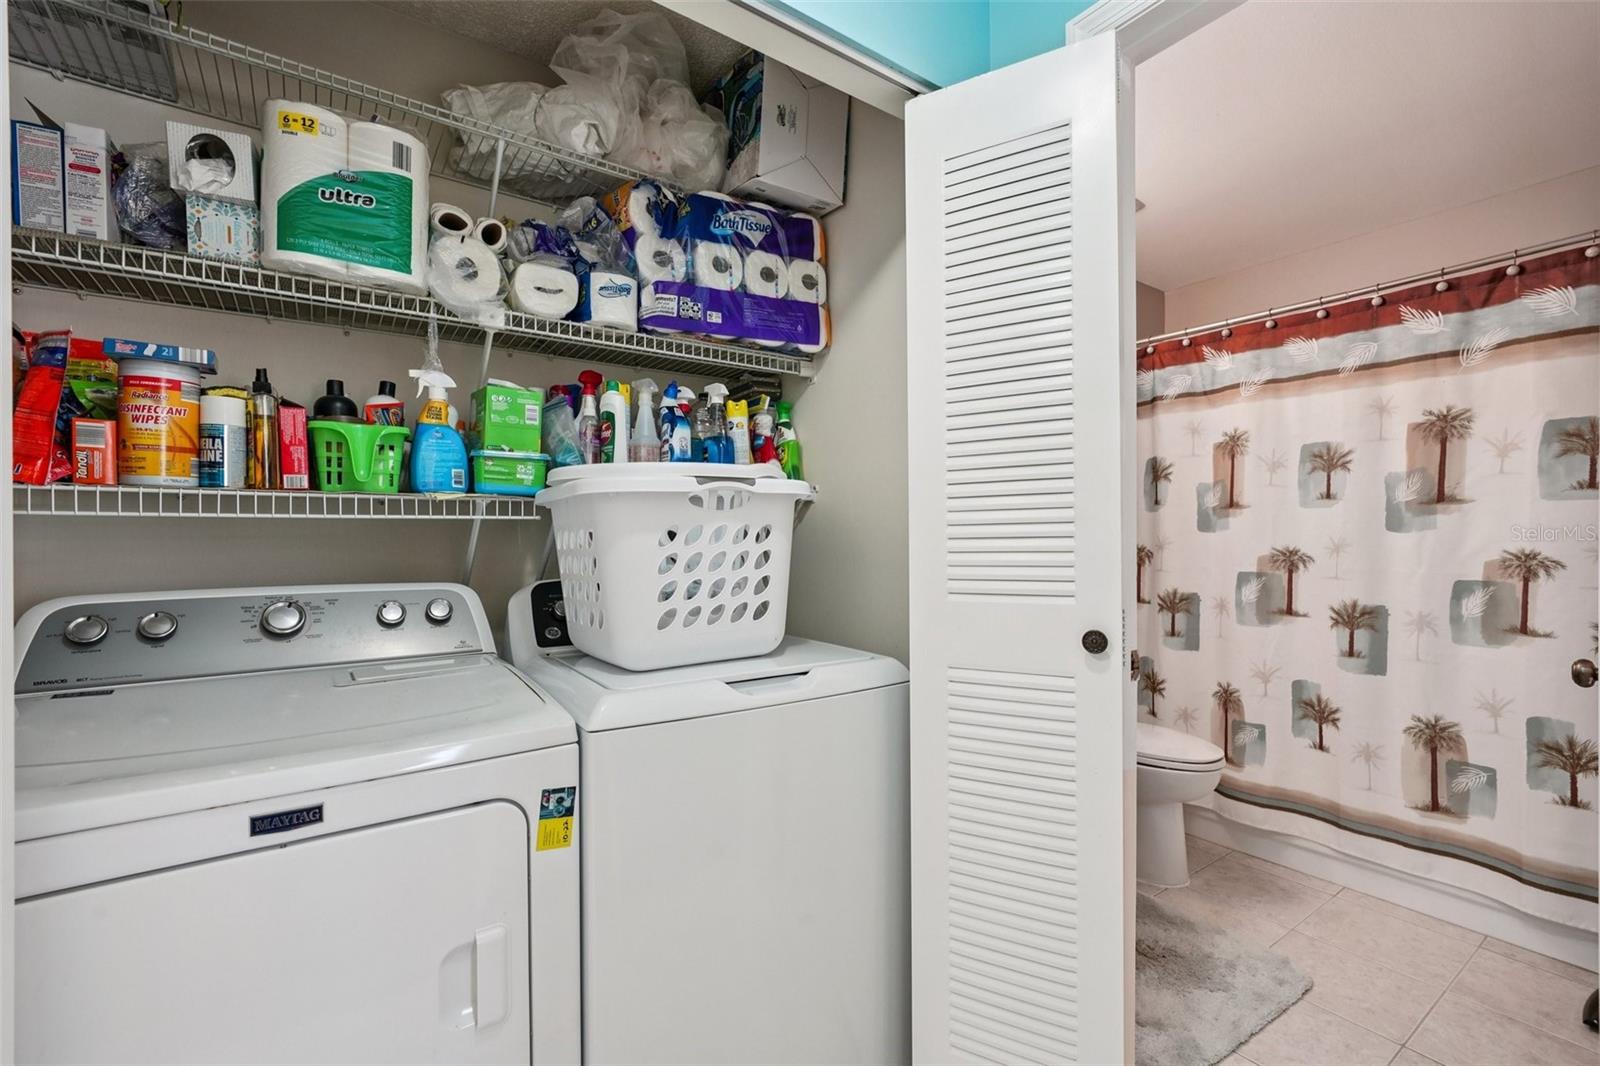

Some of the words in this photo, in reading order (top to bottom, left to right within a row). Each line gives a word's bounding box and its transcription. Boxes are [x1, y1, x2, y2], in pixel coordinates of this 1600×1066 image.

[282, 114, 290, 123] 6
[300, 117, 315, 128] 12
[319, 187, 375, 208] ultra
[161, 347, 169, 356] 2
[131, 390, 168, 401] Radiance
[131, 414, 168, 425] WIPES
[254, 808, 321, 832] MAYTAG
